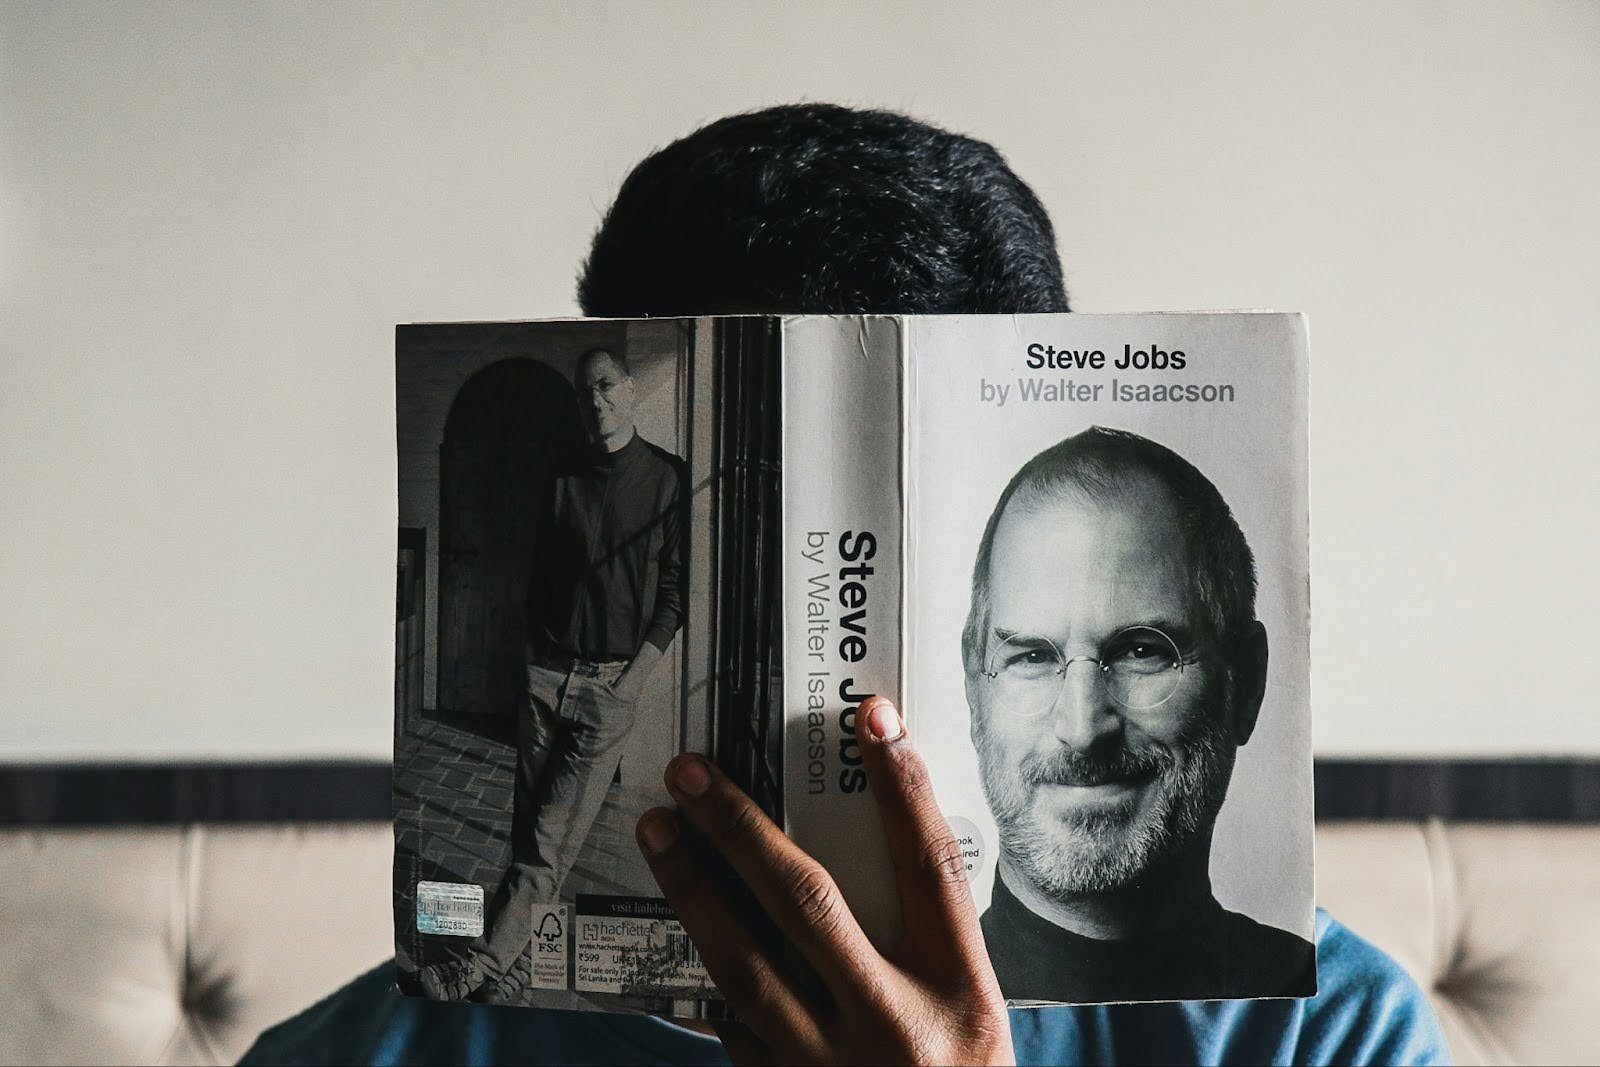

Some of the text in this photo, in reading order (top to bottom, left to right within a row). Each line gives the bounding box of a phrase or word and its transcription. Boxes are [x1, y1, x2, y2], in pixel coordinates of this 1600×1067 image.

[1026, 343, 1187, 370] Steve Jobs
[980, 378, 1235, 407] by Walter Isaacson
[838, 530, 877, 663] Steve
[801, 531, 830, 795] by Walter Isaacson
[957, 836, 973, 845] ook
[963, 849, 979, 857] ired
[600, 921, 651, 937] hachette
[538, 943, 562, 953] FSC
[578, 952, 599, 962] ₹599
[604, 968, 619, 976] only
